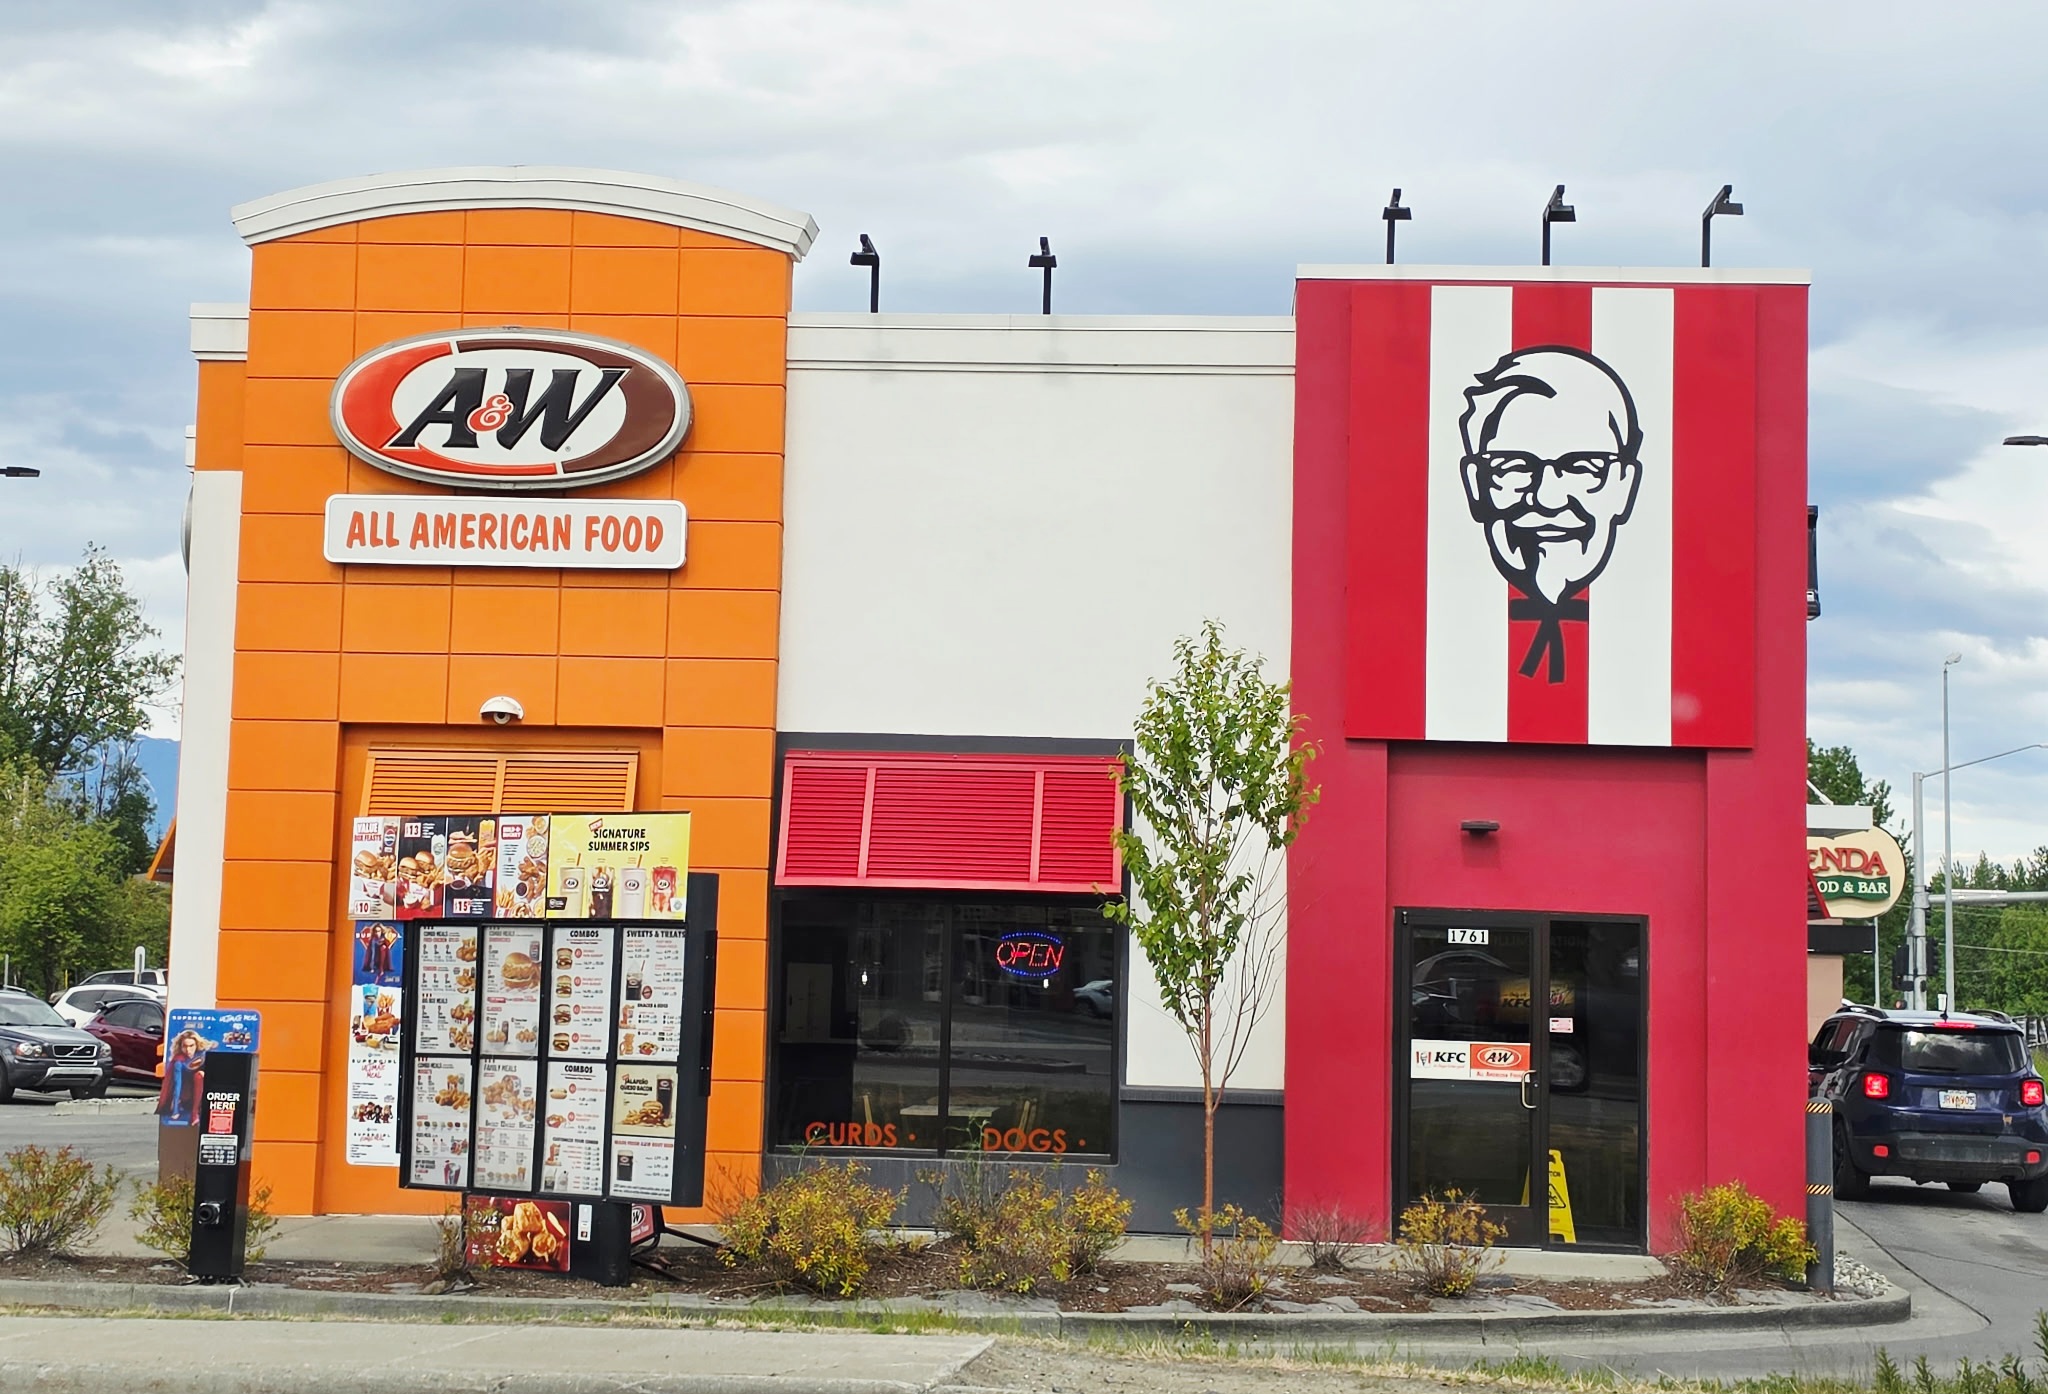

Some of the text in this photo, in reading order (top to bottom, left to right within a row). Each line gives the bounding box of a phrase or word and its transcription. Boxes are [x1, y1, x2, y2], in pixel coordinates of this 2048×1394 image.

[385, 368, 630, 451] A&W
[346, 511, 663, 552] ALL AMERICAN FOOD
[593, 828, 646, 839] SIGNATURE
[588, 841, 650, 851] SUMMER SIPS
[1843, 881, 1854, 893] &
[1858, 882, 1888, 894] BAR
[570, 930, 599, 938] COMBOS
[654, 930, 660, 938] &
[1452, 930, 1485, 943] 1761
[996, 942, 1064, 967] OPEN
[1434, 1051, 1466, 1063] KFC
[564, 1064, 593, 1074] COMBOS
[206, 1092, 240, 1102] ORDER
[805, 1121, 897, 1148] CURDS
[983, 1128, 1067, 1154] DOGS
